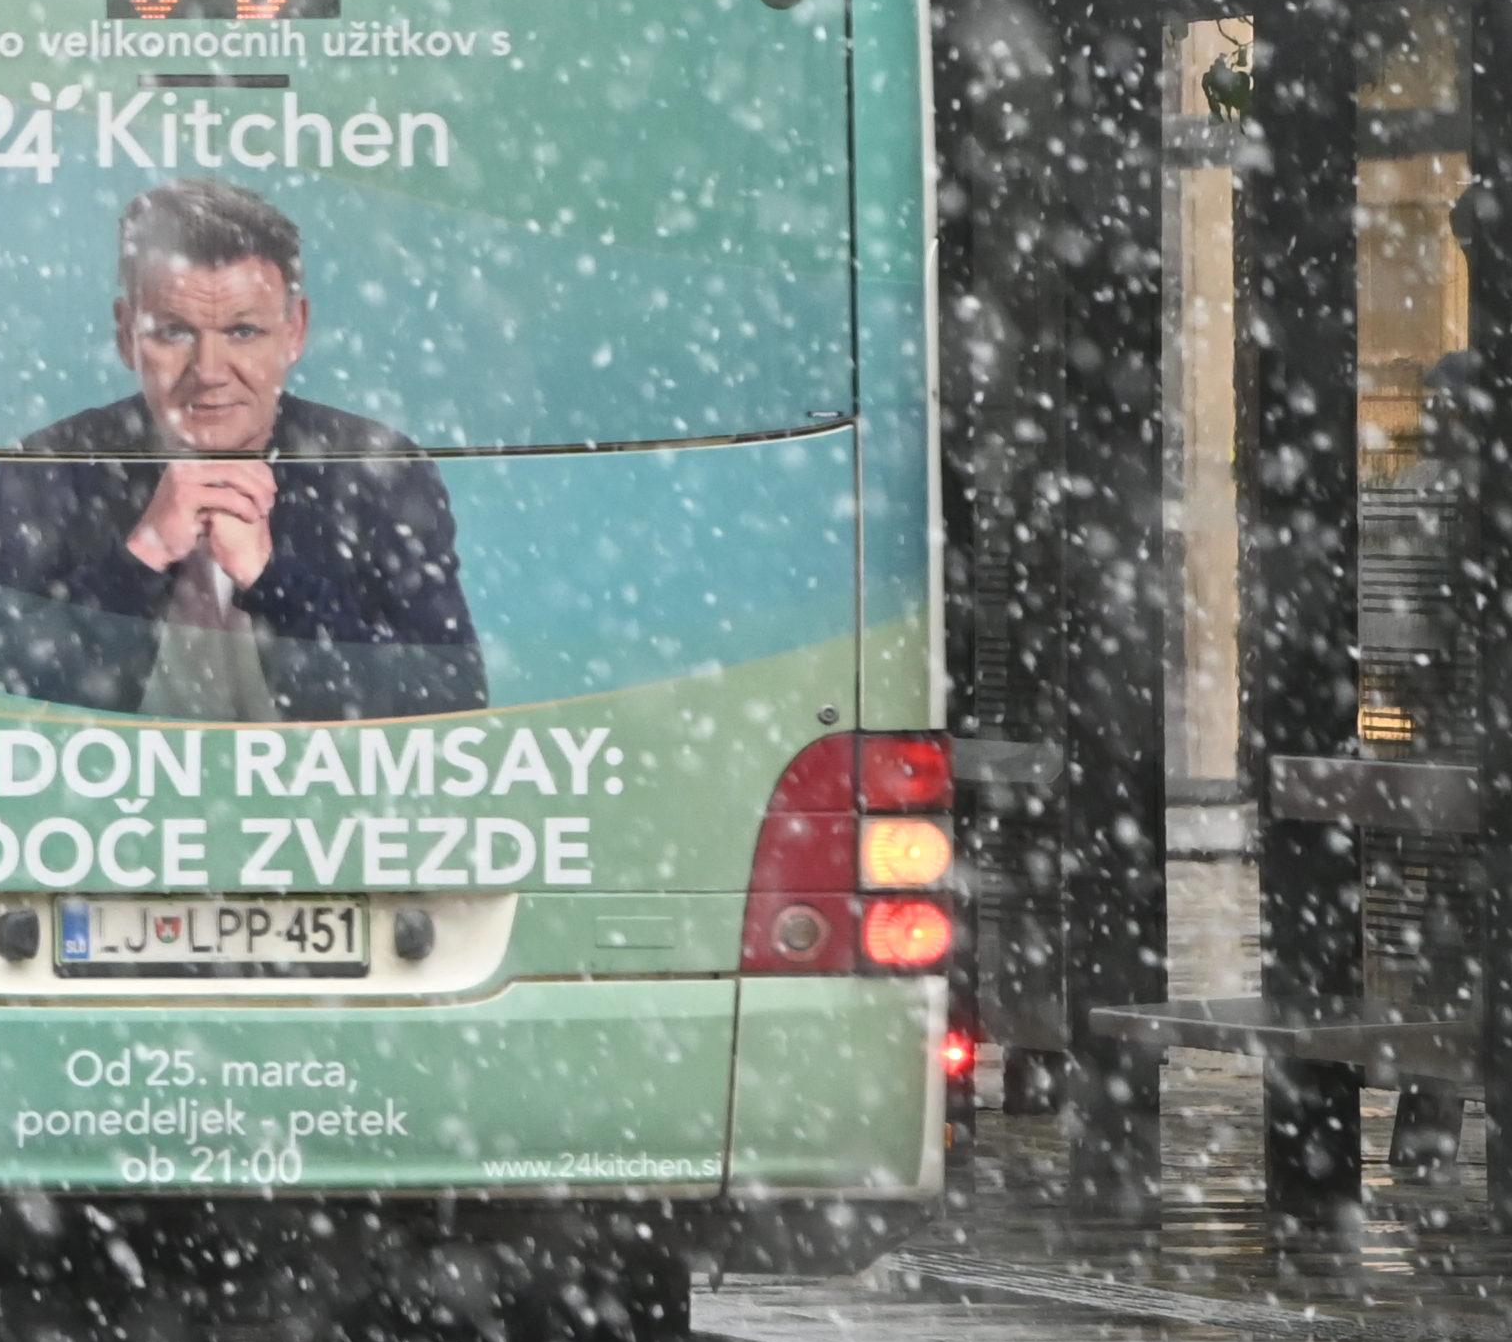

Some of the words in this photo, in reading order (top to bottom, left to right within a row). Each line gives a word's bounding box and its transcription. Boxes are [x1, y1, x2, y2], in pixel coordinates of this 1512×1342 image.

[39, 18, 306, 58] velikonočnih
[322, 19, 476, 58] užitkov
[491, 28, 513, 57] s
[98, 91, 450, 168] Kitchen
[235, 726, 624, 797] RAMSAY:
[239, 816, 593, 886] ZVEZDE
[187, 906, 355, 953] LPP-451
[66, 1047, 131, 1088] Od
[145, 1050, 207, 1088] 25.
[222, 1058, 358, 1093] marca,
[16, 1097, 246, 1148] ponedeljek
[289, 1097, 408, 1148] petek
[120, 1146, 176, 1184] ob
[190, 1146, 304, 1185] 21:00
[482, 1151, 723, 1178] www.24kitchen.si
